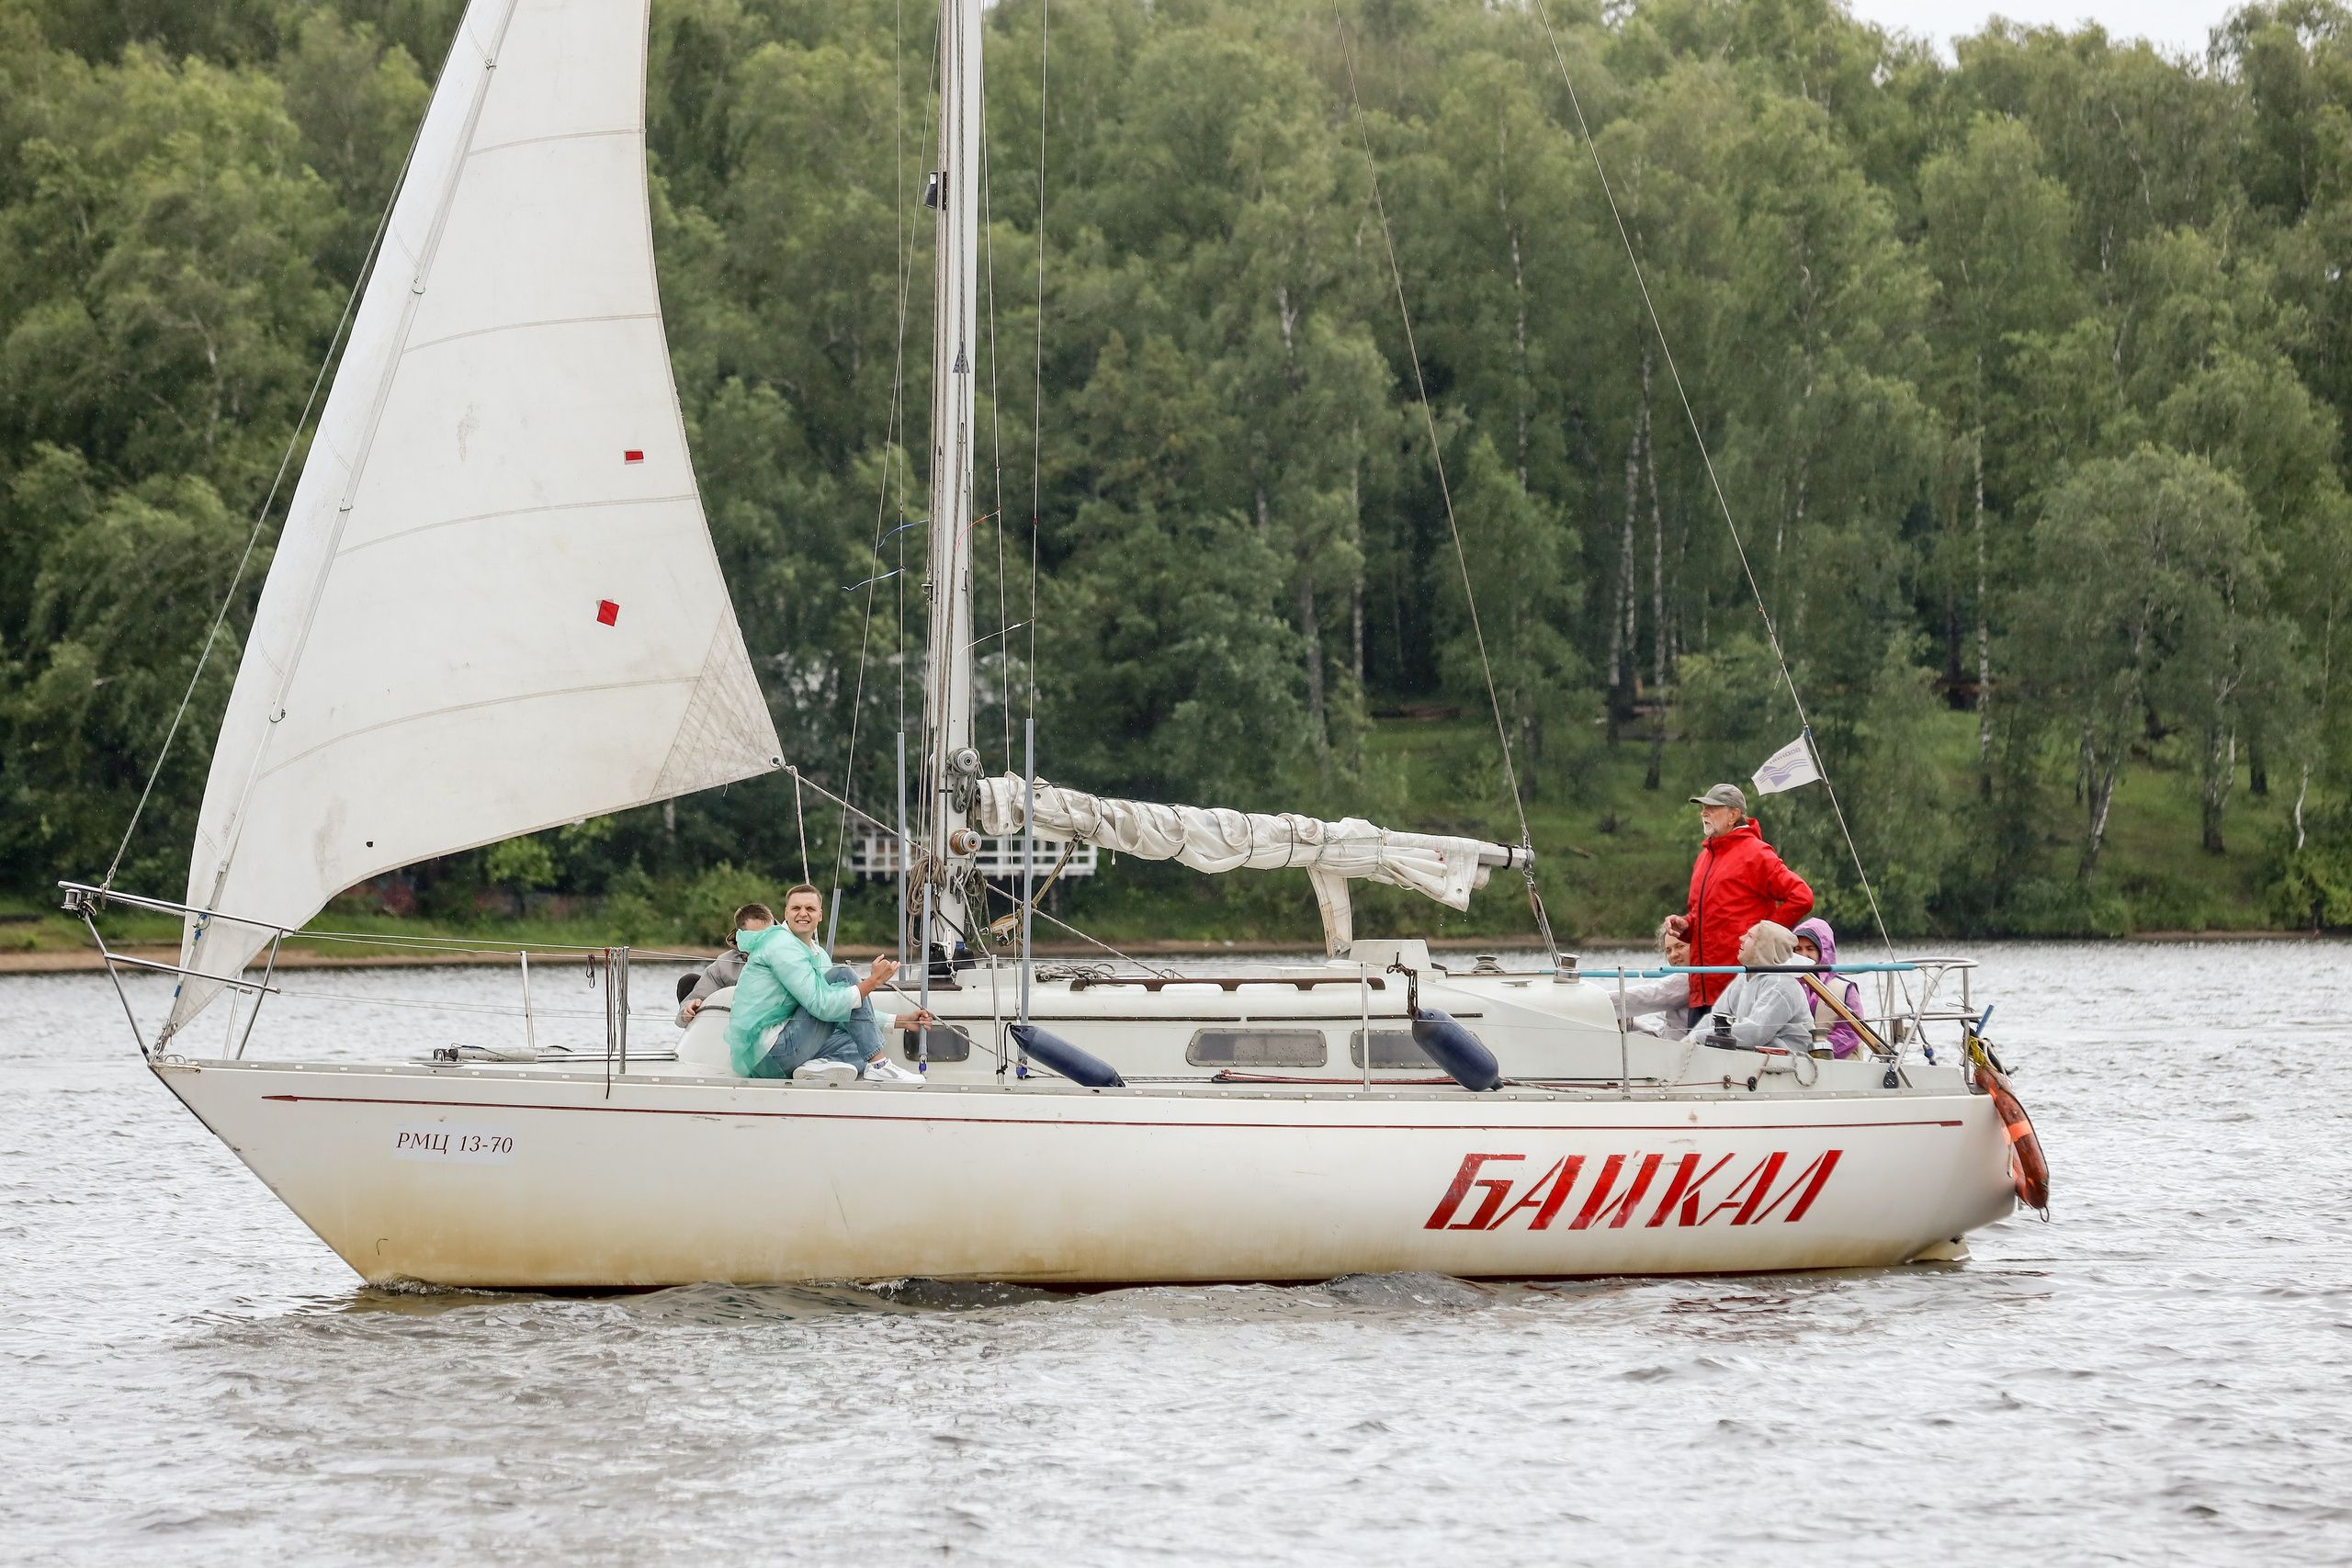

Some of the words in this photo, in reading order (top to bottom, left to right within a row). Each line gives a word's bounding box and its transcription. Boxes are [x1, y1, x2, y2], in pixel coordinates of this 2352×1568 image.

[396, 1132, 450, 1155] РМЦ
[458, 1135, 514, 1154] 13-70
[1423, 1149, 1844, 1231] БАЙКАЛ
